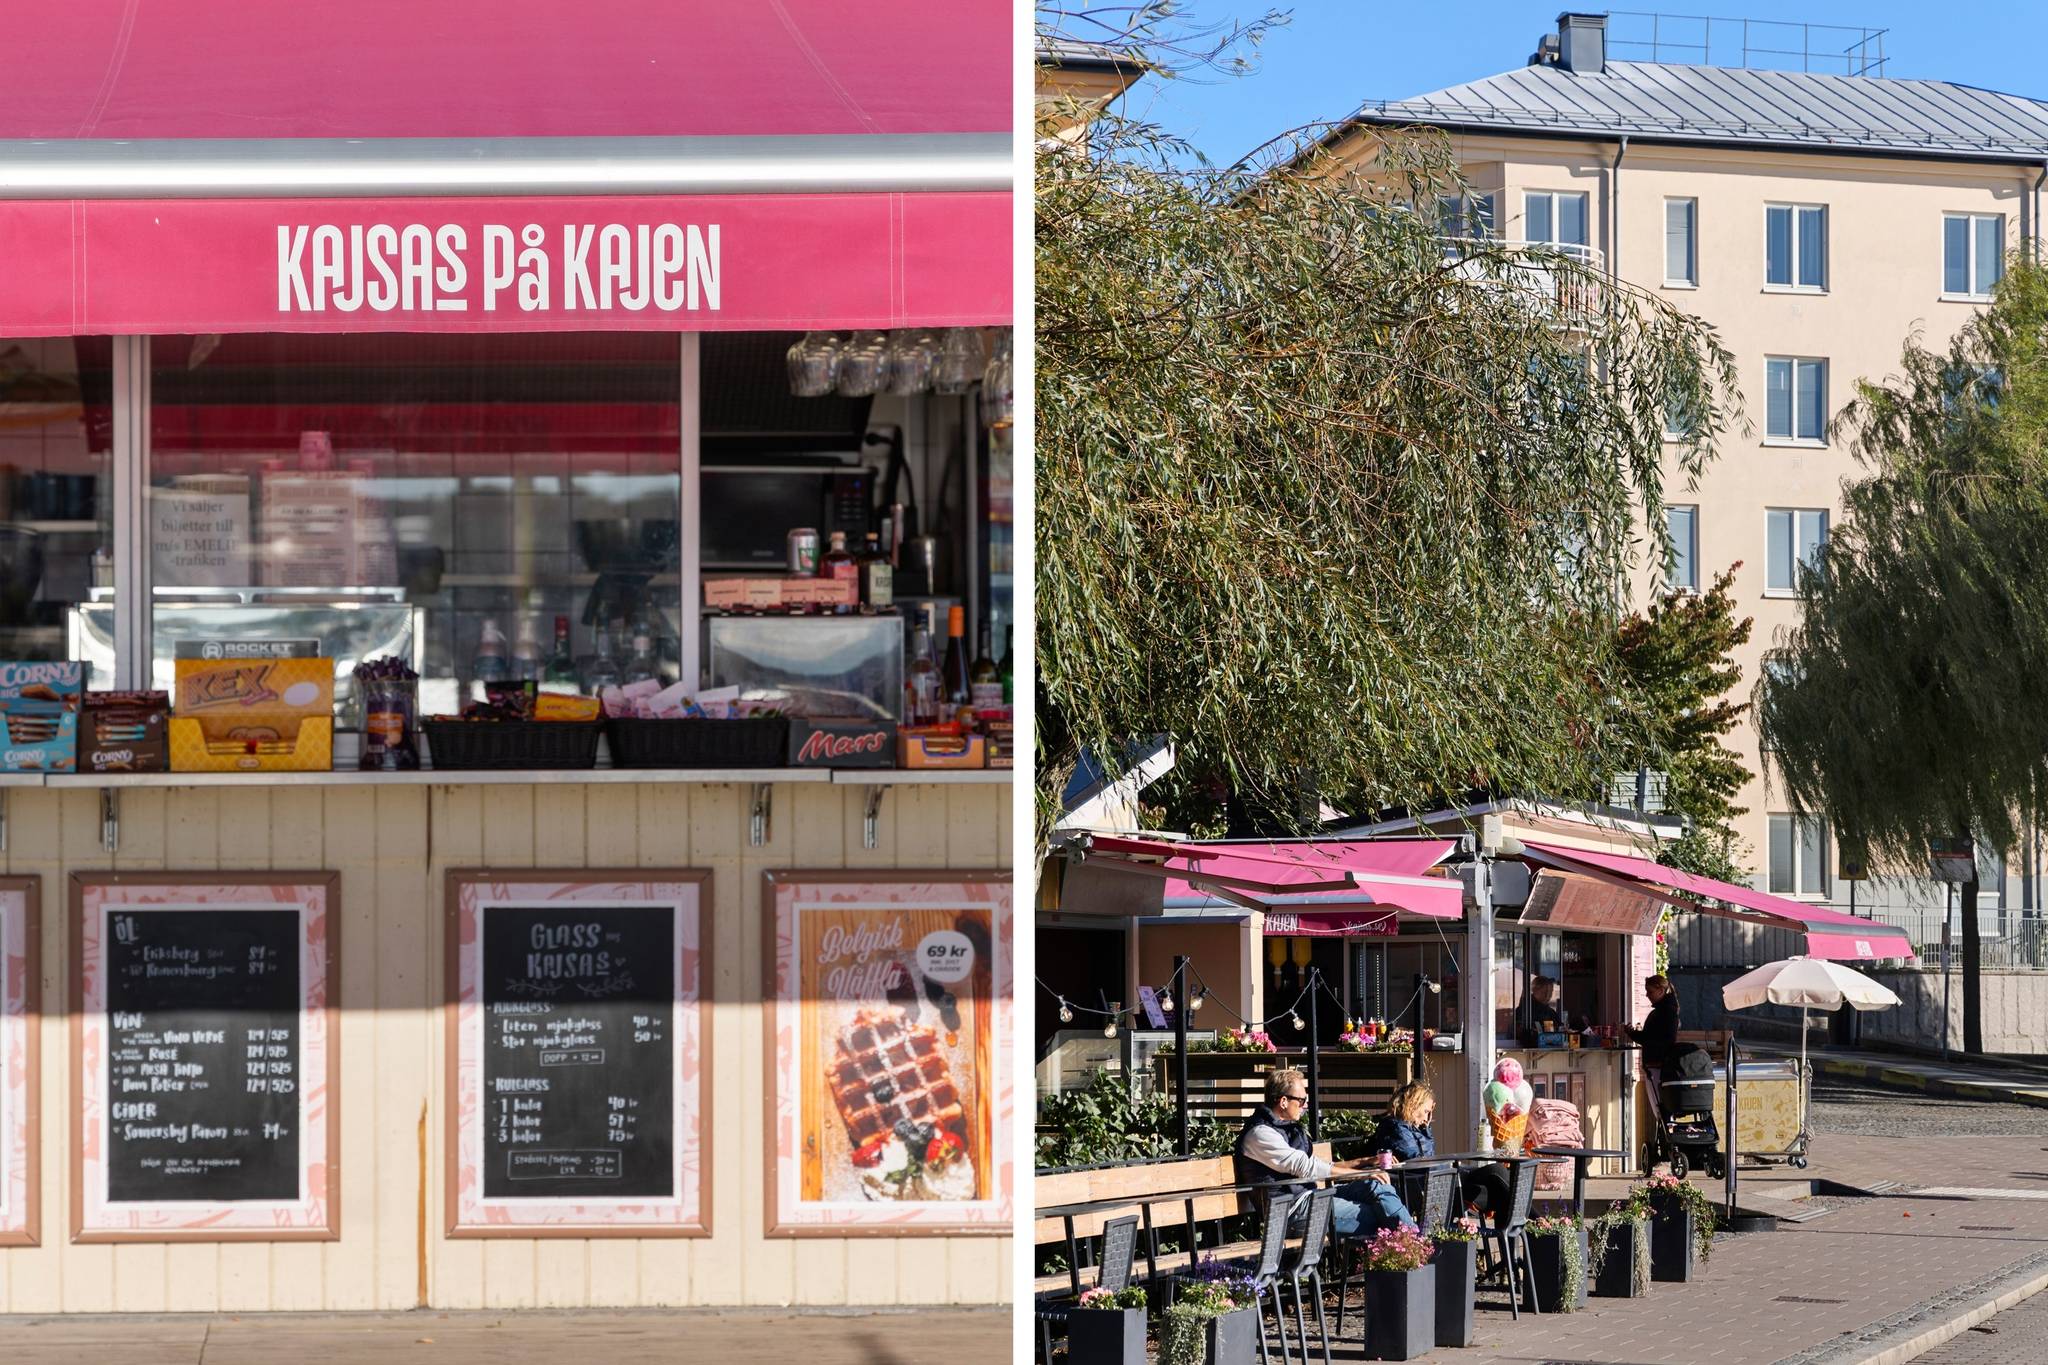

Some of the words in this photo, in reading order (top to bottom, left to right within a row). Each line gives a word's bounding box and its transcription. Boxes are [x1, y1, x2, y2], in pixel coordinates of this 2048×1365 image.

[277, 223, 468, 312] KAJSAS
[564, 223, 721, 312] KAJEN
[189, 502, 224, 515] säljer
[161, 519, 212, 536] biljetter
[216, 519, 233, 531] till
[225, 643, 292, 653] ROCKET
[0, 662, 82, 687] CORNY
[183, 662, 271, 707] KEX
[798, 730, 887, 762] Mars
[4, 750, 46, 764] CORNY
[92, 750, 133, 765] CORNY
[1265, 913, 1298, 932] KAJEN
[531, 923, 602, 950] GLASS
[818, 916, 903, 964] Belgisk
[144, 946, 200, 963] Eriksberg
[927, 945, 946, 958] 69
[950, 945, 968, 958] kr
[527, 952, 610, 980] KAJSAS
[827, 959, 902, 1002] Våffla
[503, 1019, 538, 1034] Liten
[547, 1018, 602, 1035] mjukglass
[502, 1035, 526, 1049] Stor
[533, 1033, 596, 1049] mjukglass
[634, 1031, 651, 1043] 50
[544, 1053, 568, 1064] DOPP
[495, 1078, 550, 1092] KULGLASS
[501, 1098, 508, 1113] 1
[608, 1096, 626, 1111] 40
[499, 1114, 508, 1128] 2
[512, 1114, 542, 1127] kulor
[123, 1123, 189, 1143] Somersby
[498, 1129, 508, 1143] 3
[512, 1129, 542, 1144] kulor
